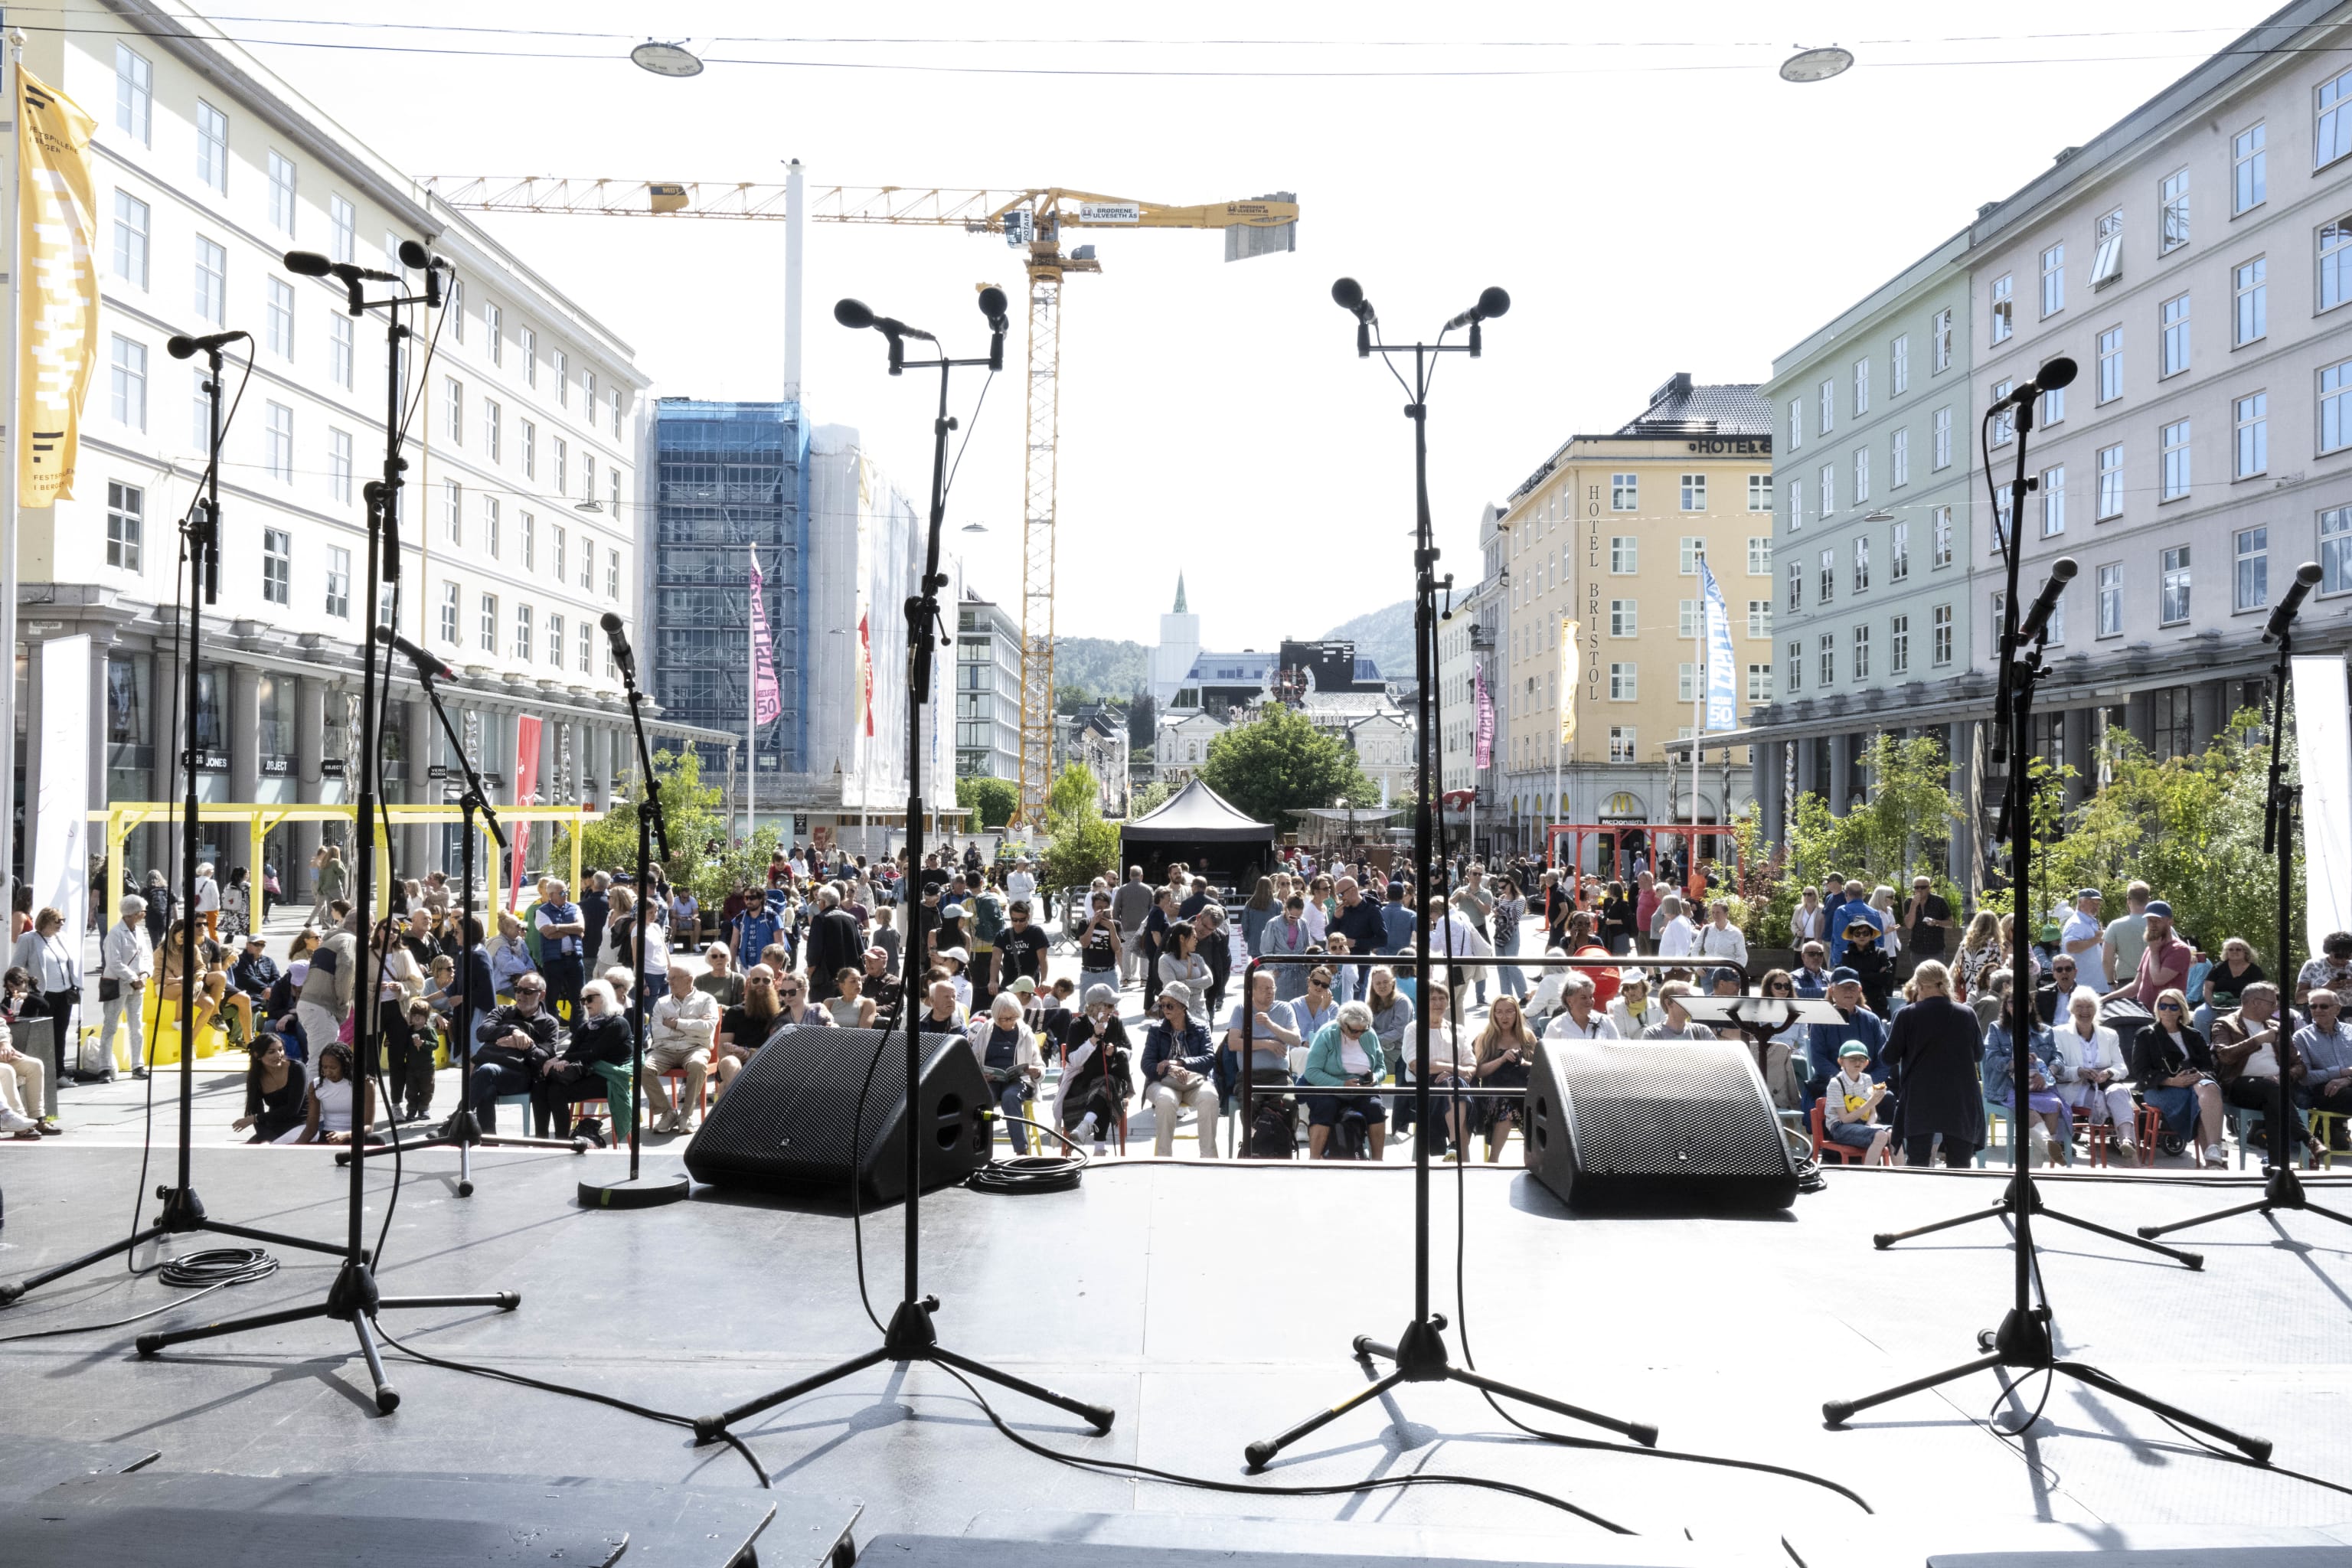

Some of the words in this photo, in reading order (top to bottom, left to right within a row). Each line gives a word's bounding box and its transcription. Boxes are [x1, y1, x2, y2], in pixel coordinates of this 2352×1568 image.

[1698, 440, 1759, 453] HOTEL
[1589, 485, 1599, 567] HOTEL
[1589, 583, 1599, 701] BRISTOL
[758, 697, 777, 715] 50
[1709, 706, 1733, 724] 50
[206, 757, 227, 768] JONES
